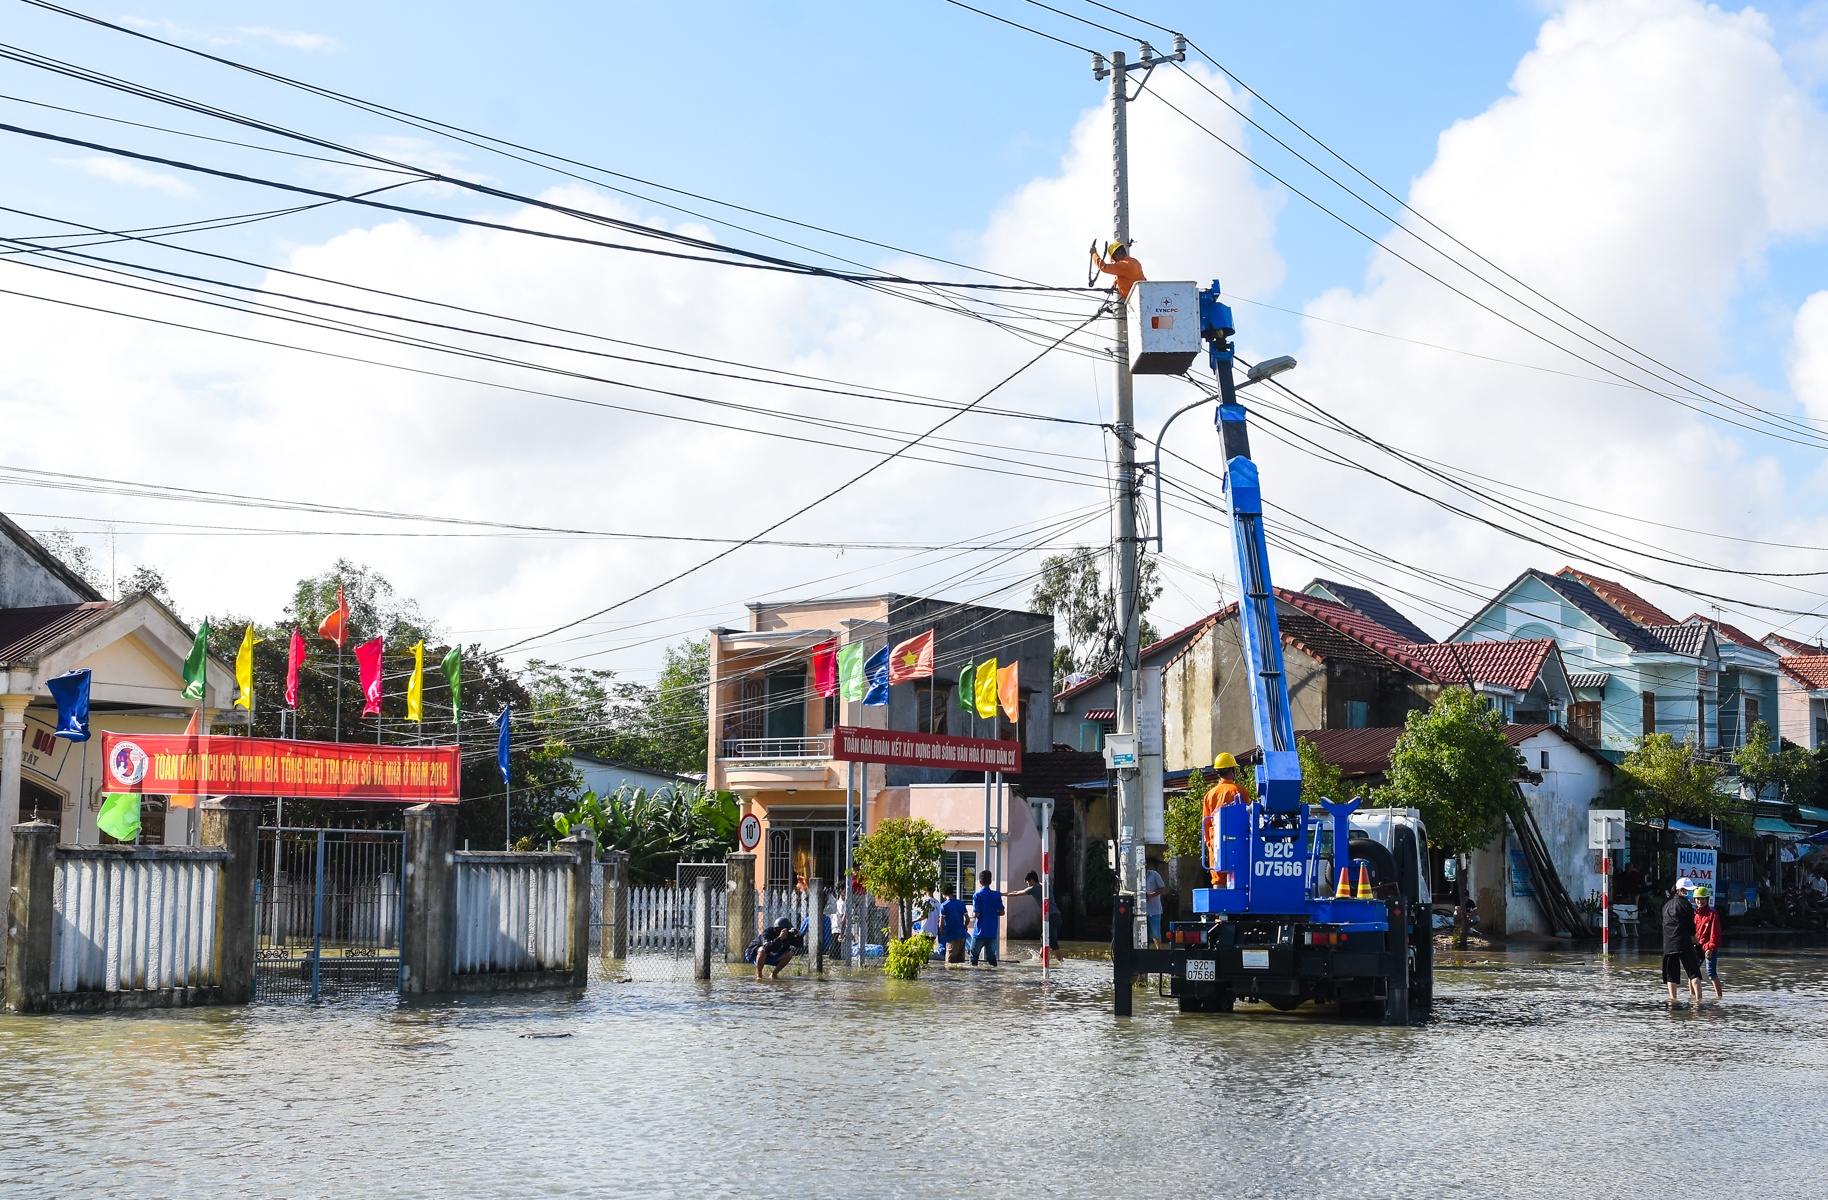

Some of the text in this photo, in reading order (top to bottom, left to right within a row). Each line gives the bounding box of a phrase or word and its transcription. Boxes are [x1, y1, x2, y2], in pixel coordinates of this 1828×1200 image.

[844, 734, 860, 753] TOÀN
[860, 735, 873, 755] DÂN
[873, 736, 889, 756] ĐOÀN
[891, 736, 902, 757] KẾT
[902, 739, 914, 757] XÂY
[915, 742, 931, 762] DỰNG
[932, 741, 940, 760] ĐỜI
[942, 741, 956, 761] SỐNG
[957, 744, 968, 762] VĂN
[969, 744, 980, 763] HÓA
[985, 749, 996, 764] KHU
[997, 747, 1007, 765] DÂN
[1008, 750, 1016, 765] CƯ
[22, 751, 39, 766] TÂY
[154, 748, 179, 780] TOÀN
[181, 749, 199, 780] DÂN
[201, 749, 218, 781] TÍCH
[220, 752, 237, 788] CỰC
[239, 756, 263, 782] THAM
[264, 756, 279, 783] GIA
[281, 747, 303, 784] TỔNG
[304, 750, 323, 784] ĐIỀU
[326, 759, 340, 784] TRA
[342, 754, 359, 785] DÂN
[361, 753, 372, 786] SỐ
[374, 756, 383, 785] VÀ
[386, 756, 401, 786] NHÀ
[403, 753, 410, 786] Ở
[410, 756, 428, 786] NĂM
[430, 762, 447, 786] 2019
[1264, 842, 1294, 858] 92C
[1680, 851, 1714, 865] HONDA
[1255, 861, 1303, 877] 07566
[1680, 867, 1712, 879] LÂM
[1193, 961, 1209, 970] 92C
[1188, 971, 1215, 980] 075.66
